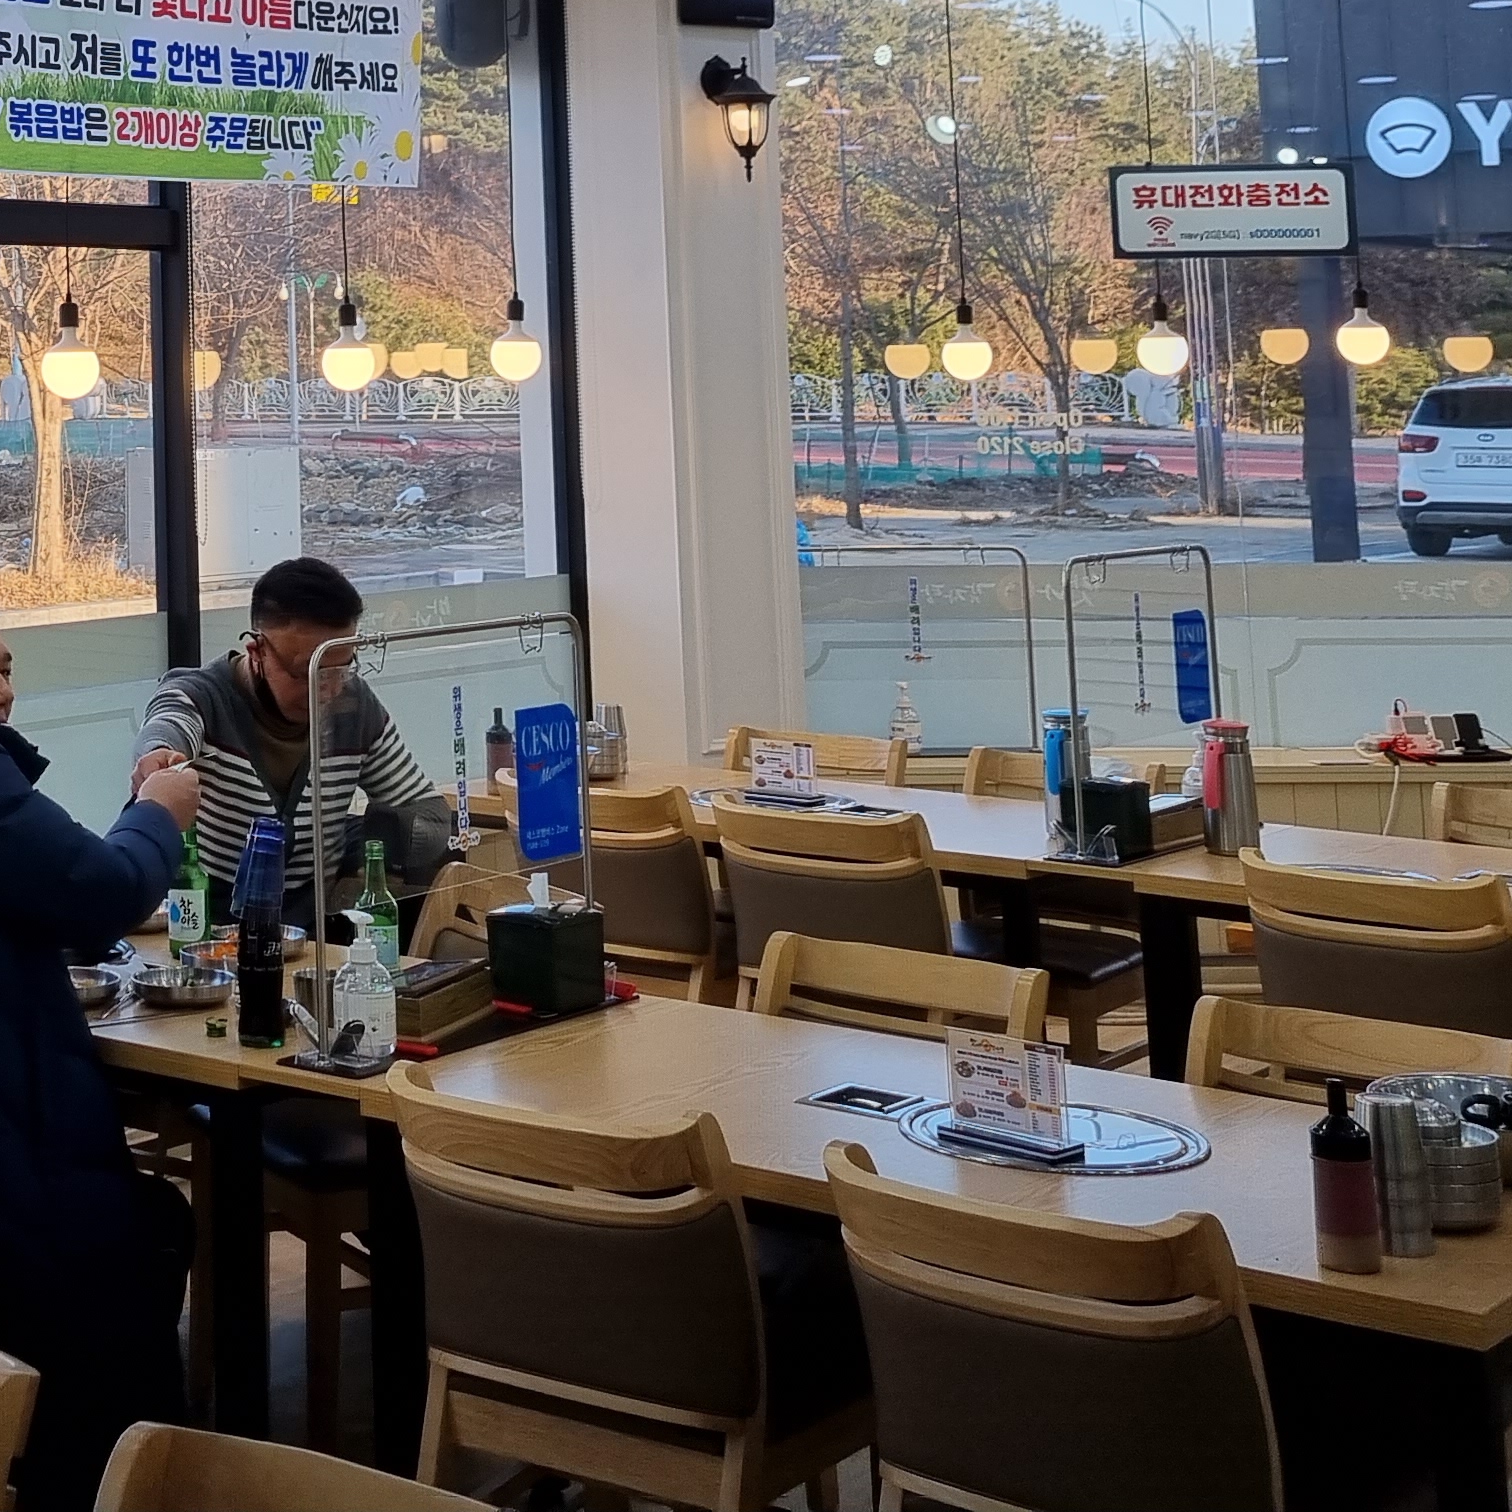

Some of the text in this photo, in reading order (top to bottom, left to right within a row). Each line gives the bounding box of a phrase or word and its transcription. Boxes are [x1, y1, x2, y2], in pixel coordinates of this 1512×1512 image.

[70, 32, 122, 77] 저를
[131, 38, 158, 80] 또
[166, 42, 223, 85] 한번
[230, 46, 310, 90] 놀라게
[310, 52, 399, 93] 해주세요
[8, 100, 109, 144] 볶음밥은
[115, 110, 202, 149] 2개이상
[1132, 182, 1330, 210] 휴대전화충전소
[521, 720, 570, 757] CESCO
[539, 754, 573, 786] Members
[179, 896, 200, 930] 참이슬
